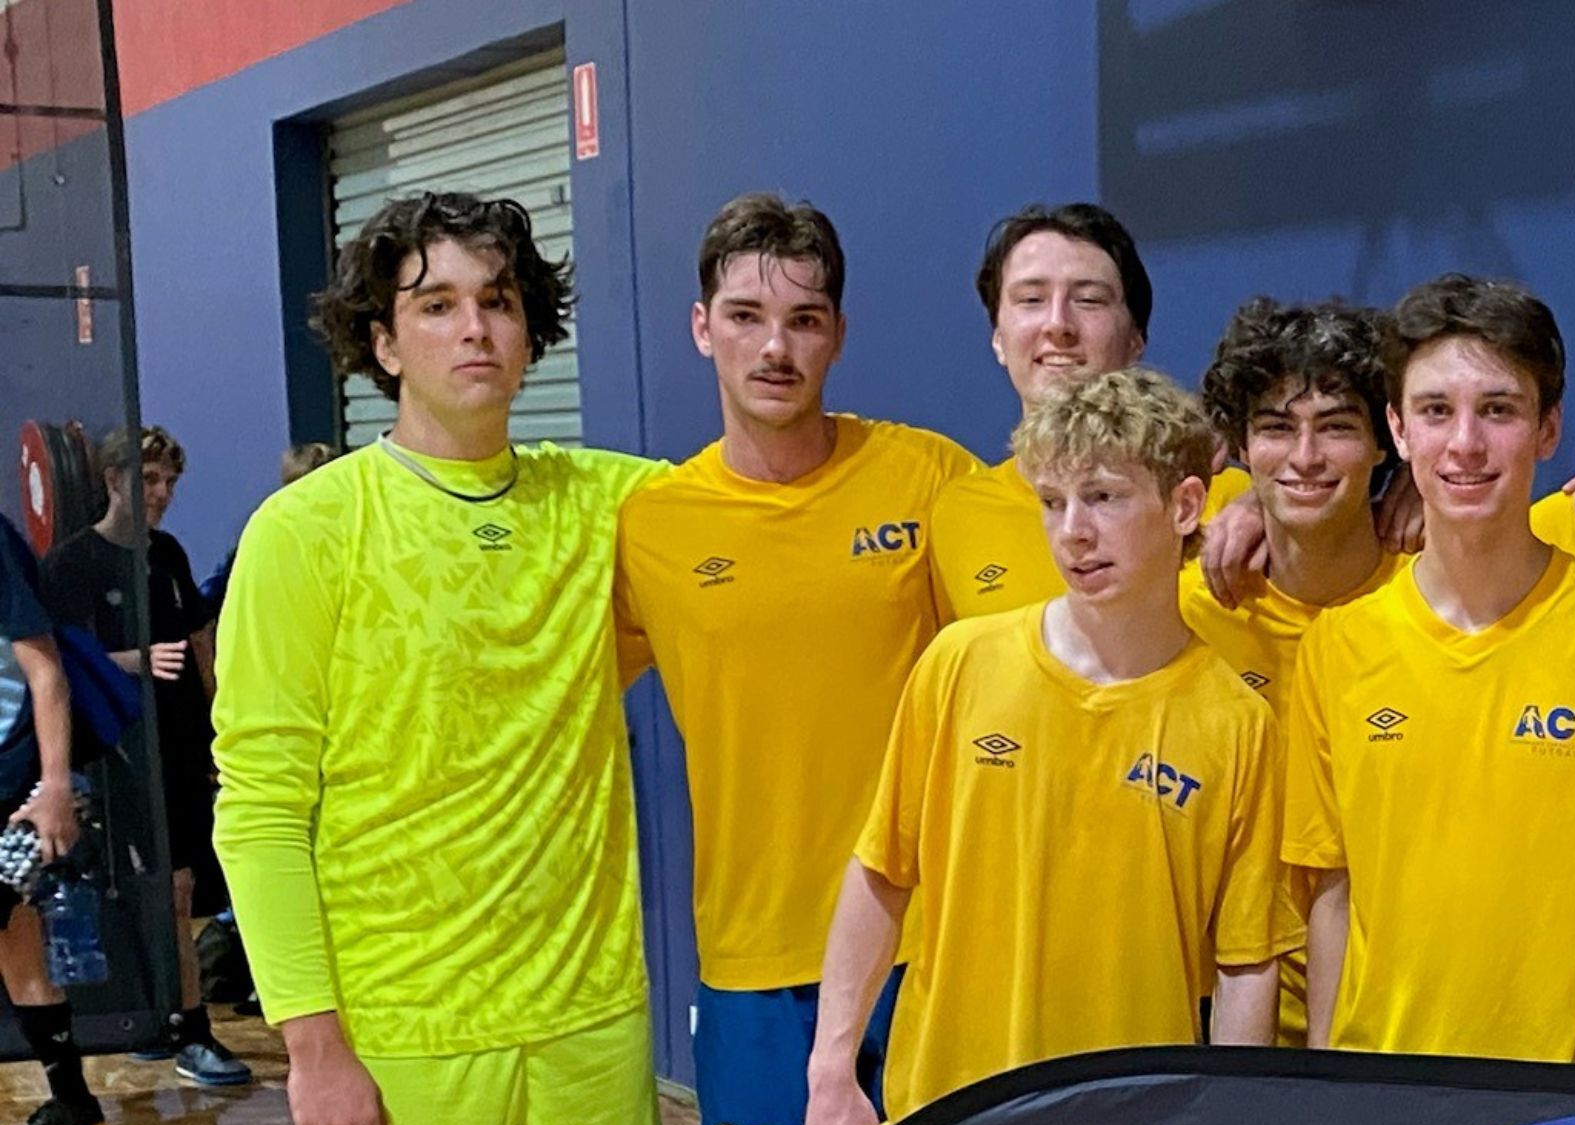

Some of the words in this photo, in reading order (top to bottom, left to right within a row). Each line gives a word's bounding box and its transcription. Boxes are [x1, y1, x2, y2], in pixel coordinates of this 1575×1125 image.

[852, 522, 920, 556] ACT
[1368, 731, 1404, 742] umbro
[975, 755, 1014, 768] umbro
[1127, 752, 1201, 808] ACT
